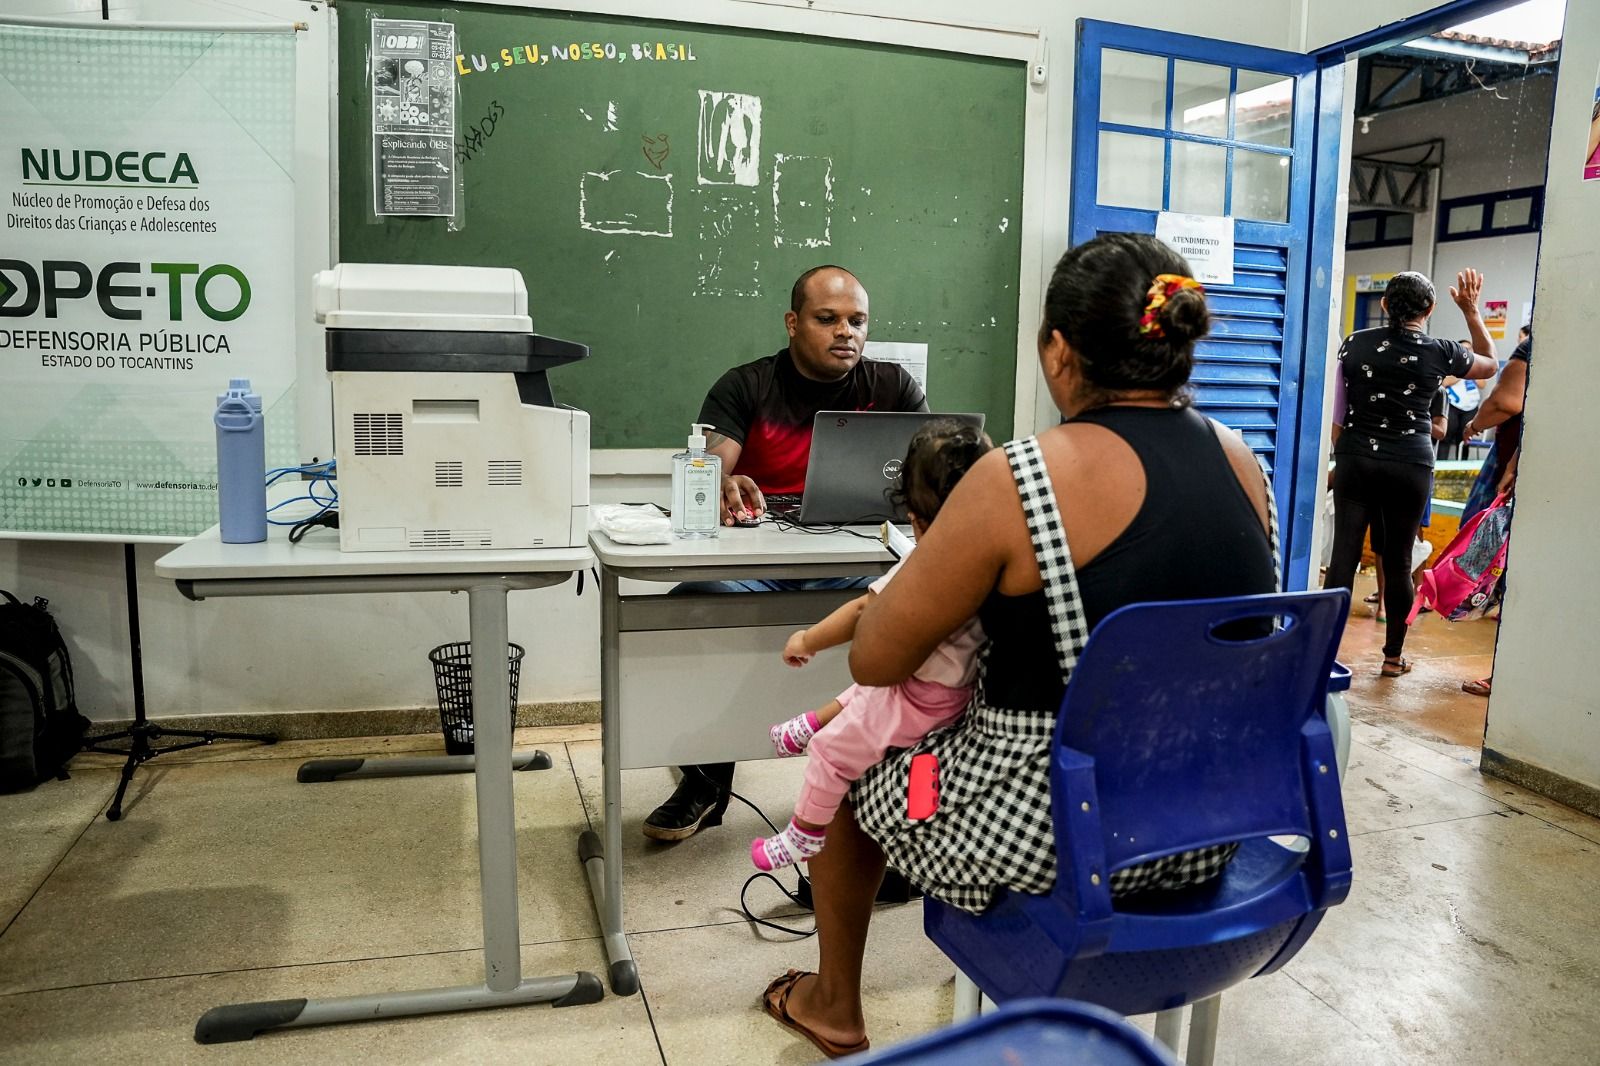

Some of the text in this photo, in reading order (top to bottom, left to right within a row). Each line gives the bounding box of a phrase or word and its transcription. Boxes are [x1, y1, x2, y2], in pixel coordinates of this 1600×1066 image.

[631, 42, 697, 61] BRASIL
[382, 139, 427, 150] Explicando
[21, 148, 200, 184] NUDECA
[12, 192, 210, 213] Núcleo de Promoção e Defesa dos
[7, 213, 217, 234] Direitos das Crianças e Adolescentes
[1171, 235, 1220, 246] ATENDIMENTO
[0, 329, 231, 353] DEFENSORIA PÚBLICA
[42, 355, 194, 370] ESTADO DO TOCANTINS
[78, 479, 122, 488] DefensoriaTO
